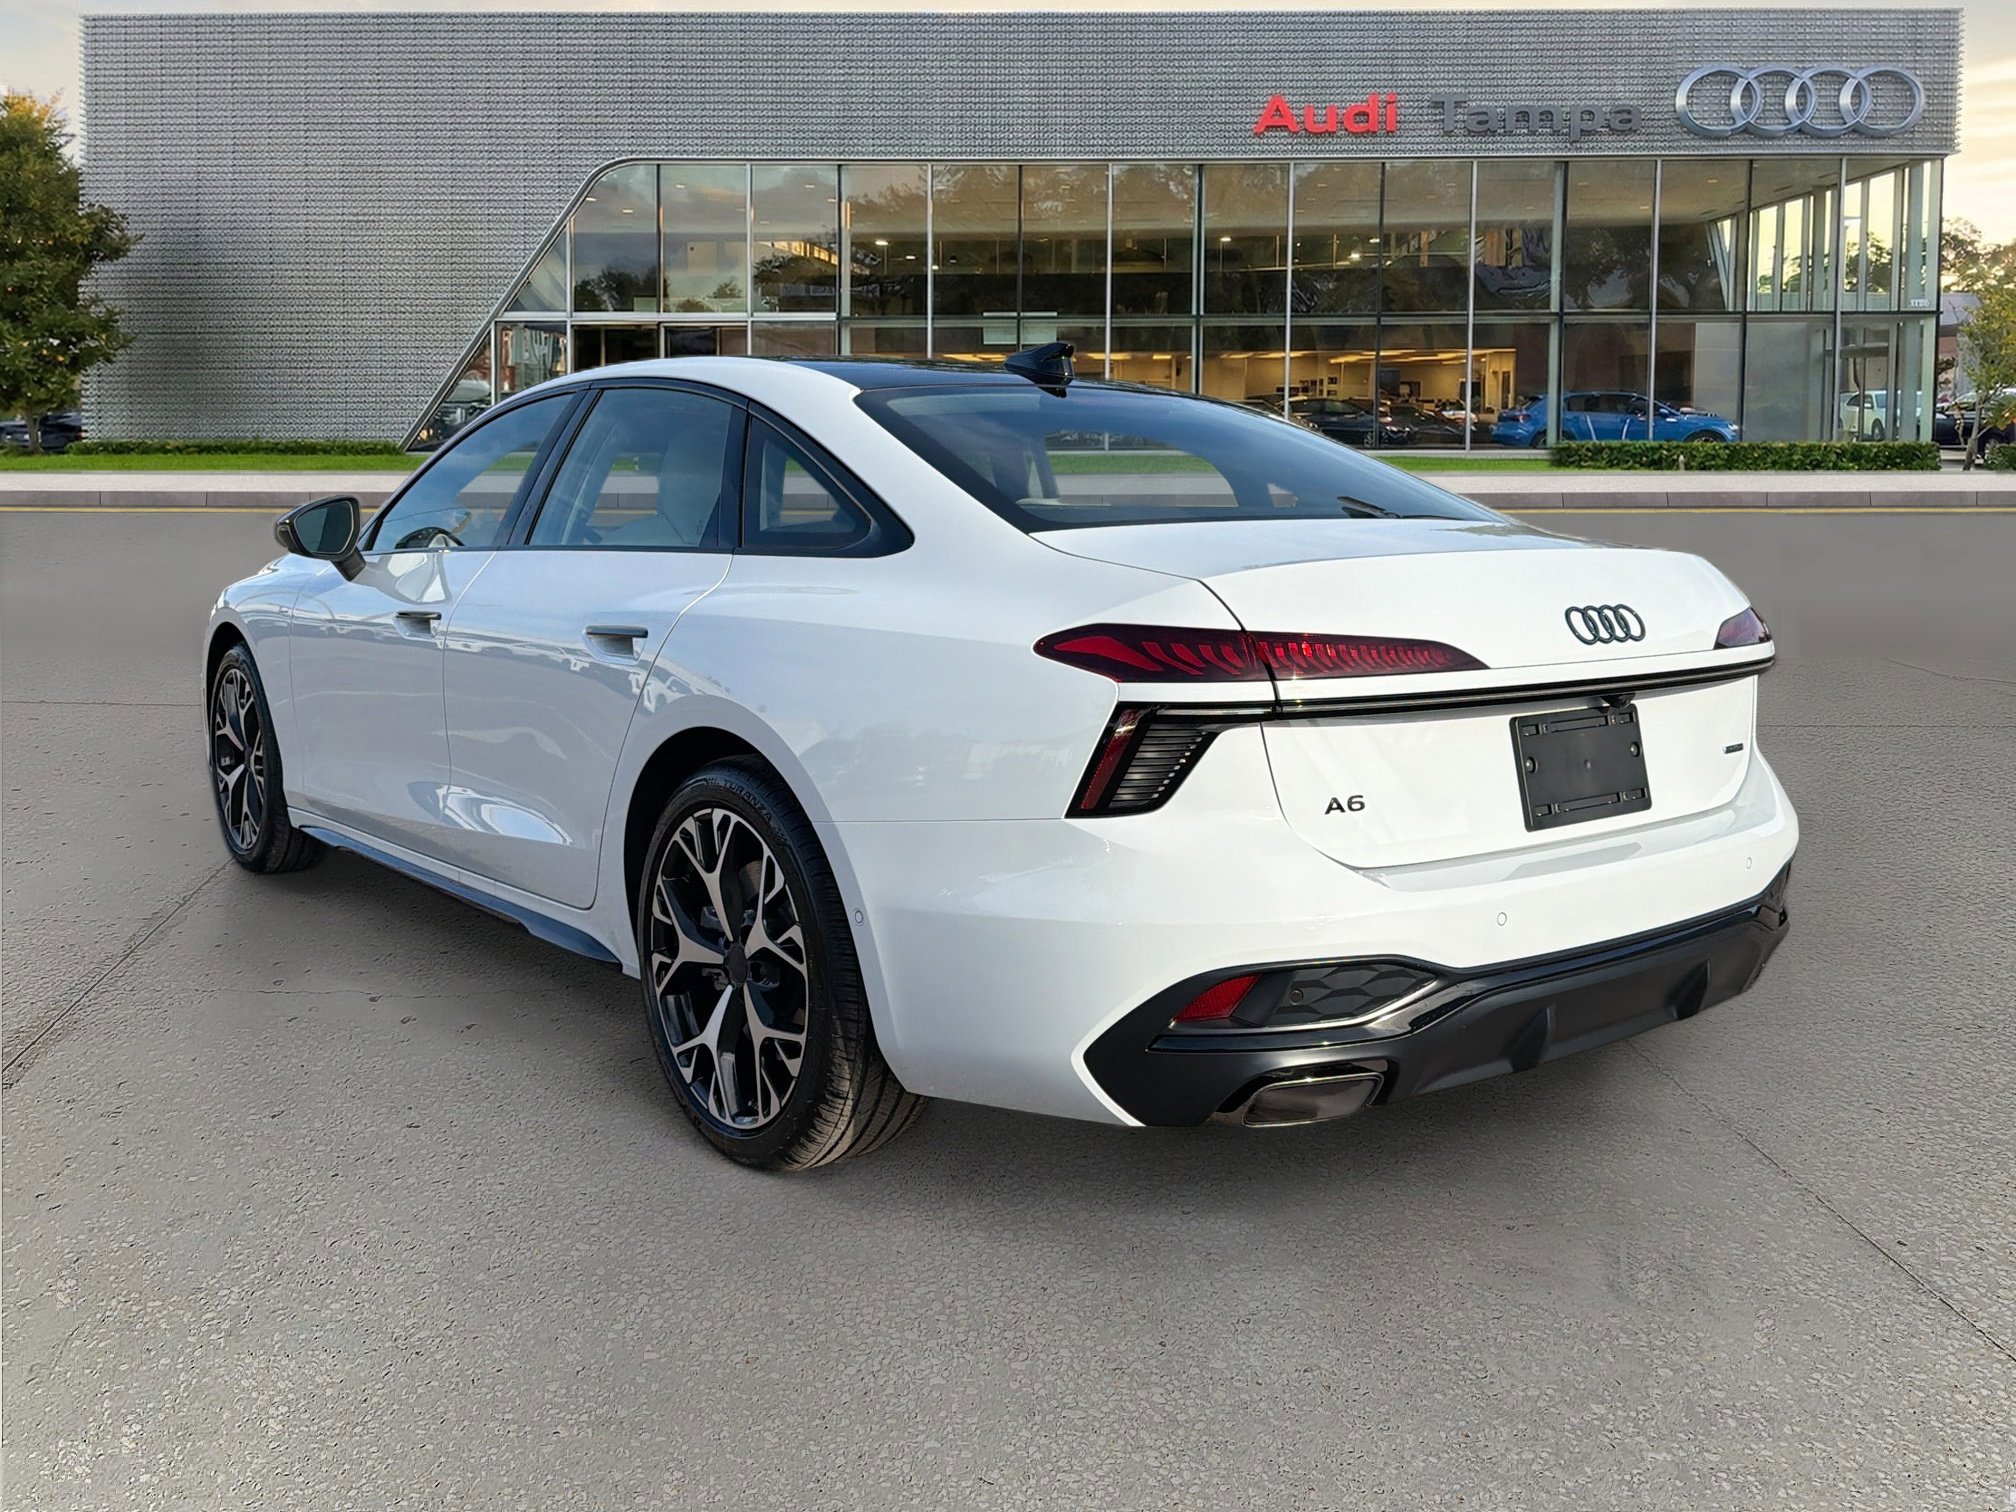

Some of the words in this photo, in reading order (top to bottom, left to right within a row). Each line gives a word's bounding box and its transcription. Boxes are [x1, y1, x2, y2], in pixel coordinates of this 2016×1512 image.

[1253, 92, 1398, 135] Audi
[1430, 92, 1642, 143] Tampa
[1324, 795, 1365, 815] A6
